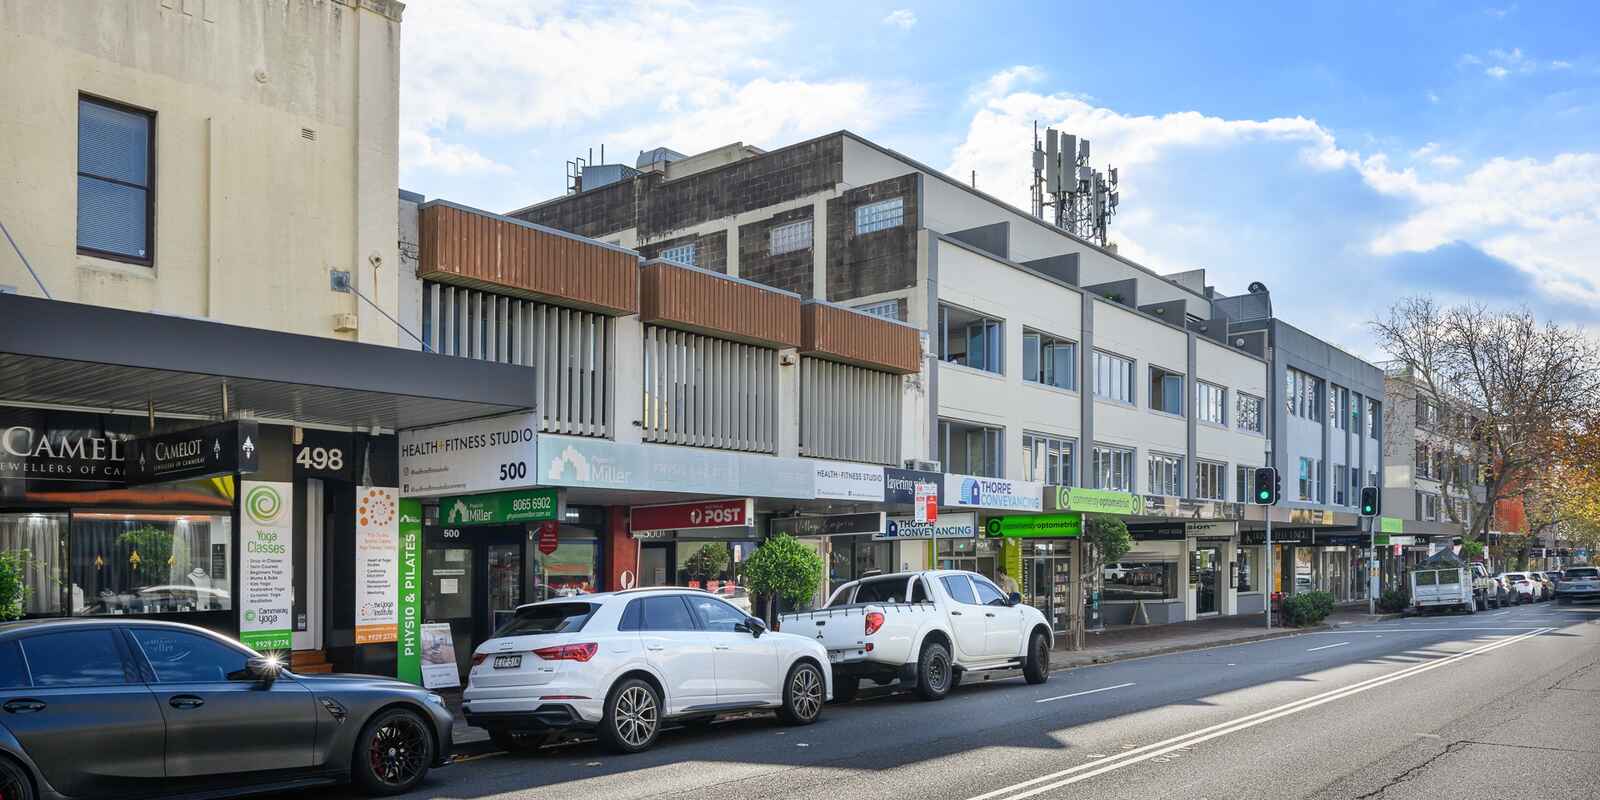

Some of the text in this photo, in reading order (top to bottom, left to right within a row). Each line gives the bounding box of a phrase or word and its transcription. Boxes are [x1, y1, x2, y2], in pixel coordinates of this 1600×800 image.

[490, 428, 533, 447] STUDIO
[155, 440, 202, 461] CAMELOT
[296, 446, 343, 470] 498
[80, 466, 97, 474] OF
[500, 461, 526, 480] 500
[591, 464, 632, 484] Miller
[982, 481, 1012, 495] THORPE
[513, 497, 551, 511] 8065 6902
[982, 495, 1040, 509] CONVEYANCING
[470, 511, 493, 521] Miller
[705, 508, 740, 523] POST
[256, 529, 278, 543] Yoga
[444, 529, 460, 538] 500
[248, 541, 286, 553] Classes
[404, 534, 416, 589] PILATES
[404, 593, 415, 603] &
[404, 607, 415, 656] PHYSIO
